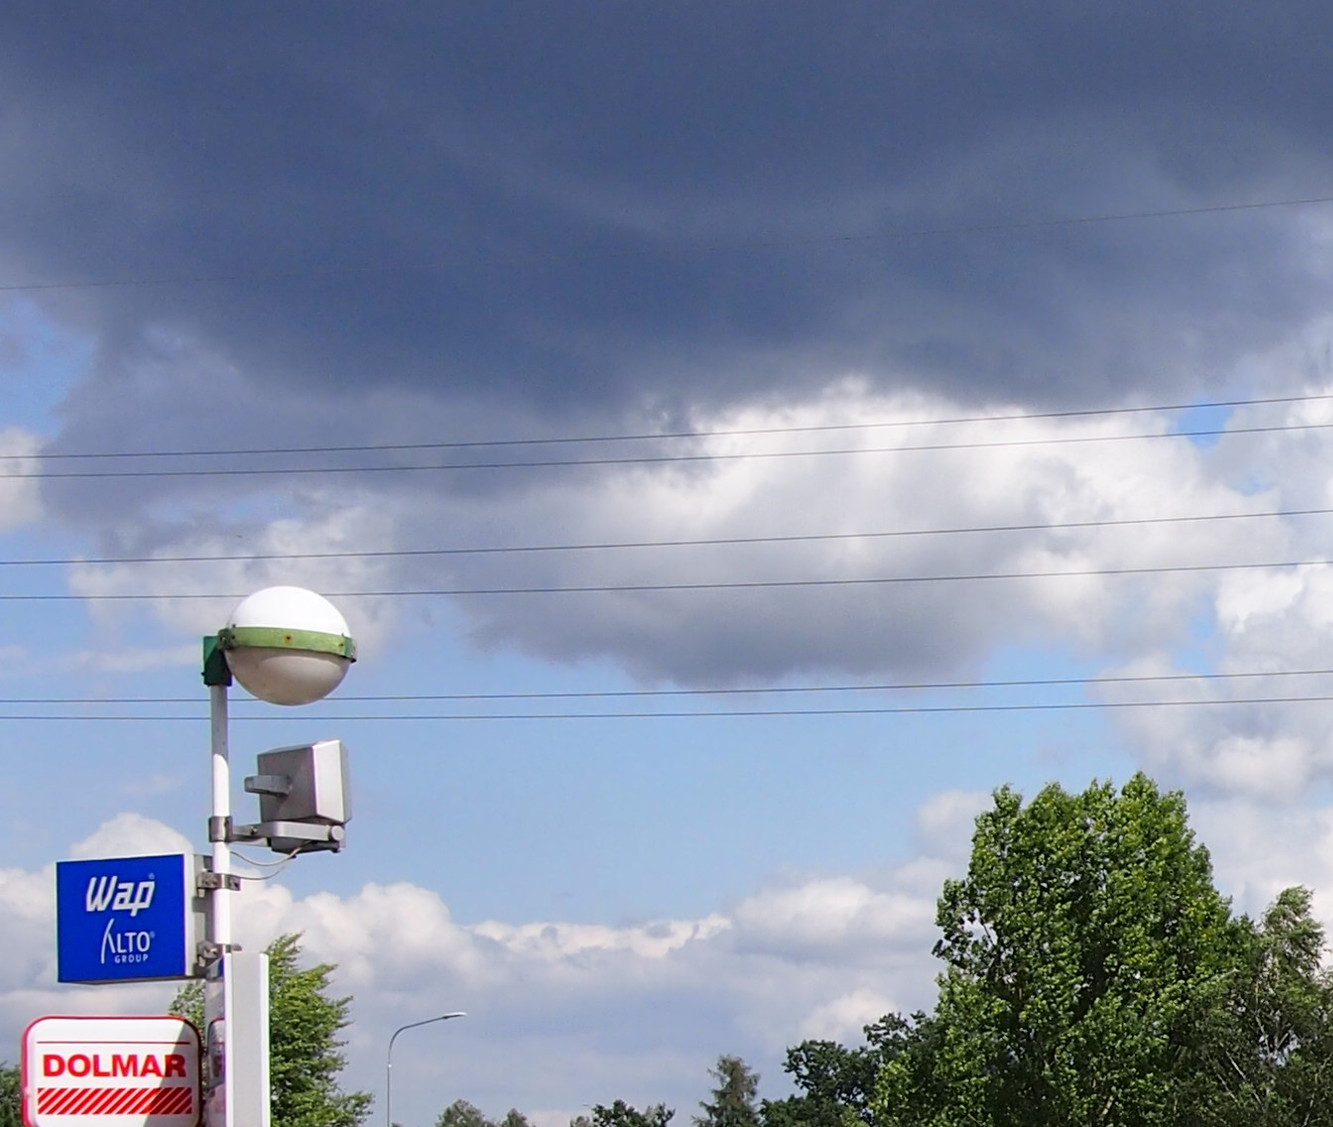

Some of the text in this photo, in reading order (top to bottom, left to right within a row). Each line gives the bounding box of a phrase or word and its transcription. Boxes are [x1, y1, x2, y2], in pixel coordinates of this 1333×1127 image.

[86, 875, 155, 917] Wap
[101, 918, 151, 964] ALTO
[114, 954, 149, 964] GROUP
[43, 1054, 186, 1077] DOLMAR
